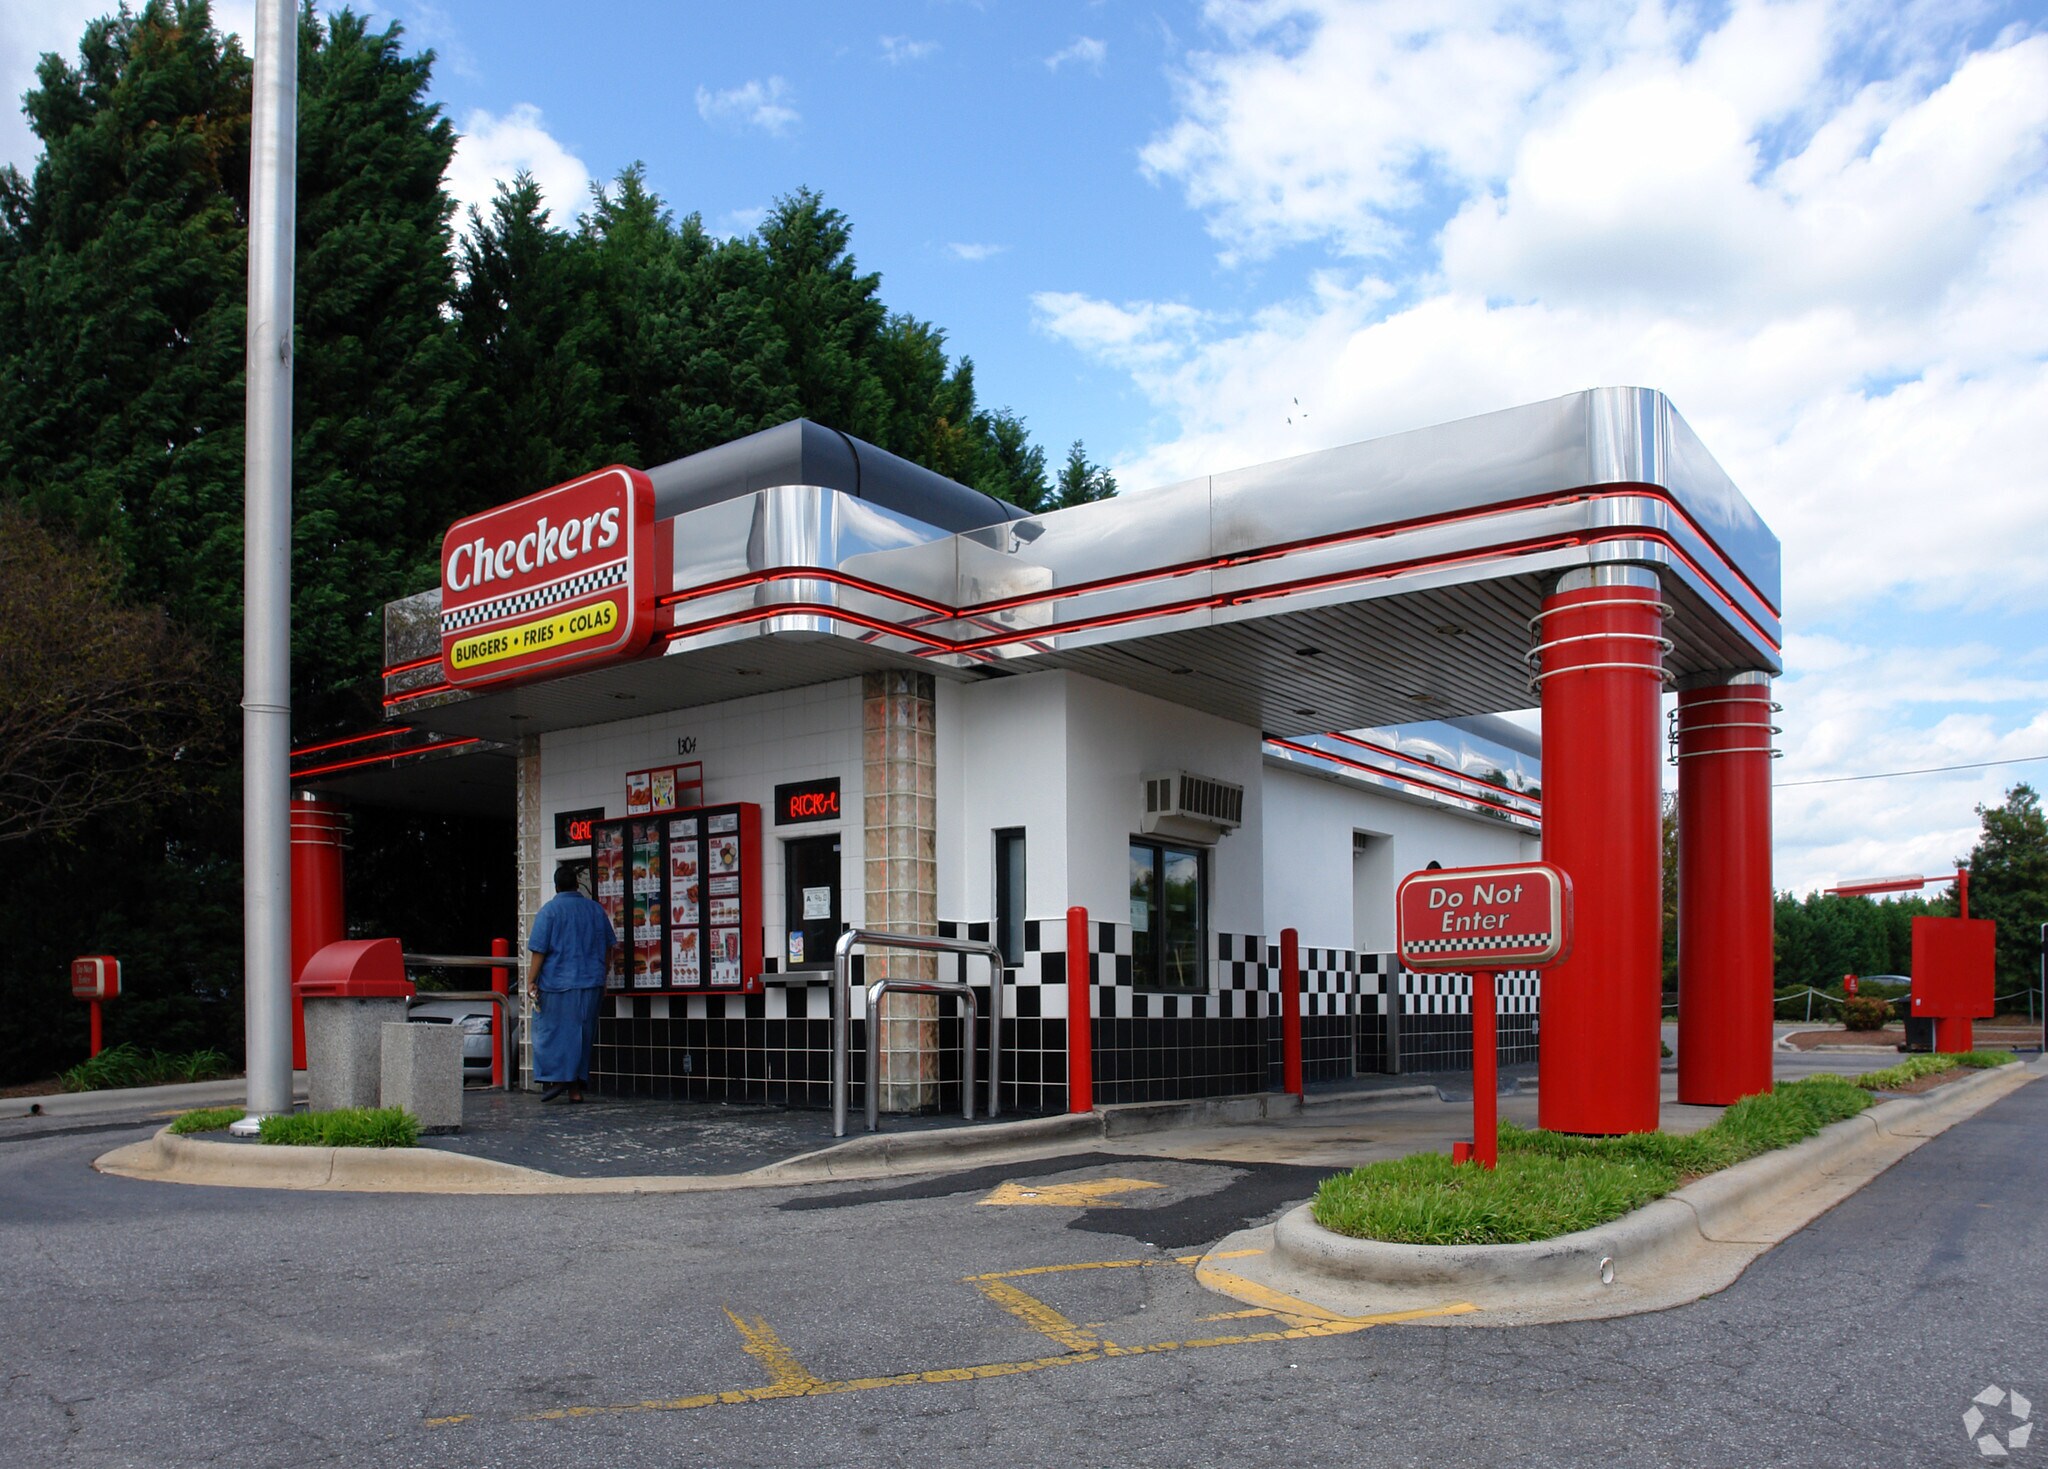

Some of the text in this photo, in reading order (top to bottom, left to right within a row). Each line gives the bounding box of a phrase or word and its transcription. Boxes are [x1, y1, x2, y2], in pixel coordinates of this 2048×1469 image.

[446, 506, 620, 592] Checkers
[455, 607, 611, 663] BURGERS FRIES COLAS
[678, 736, 697, 755] 1304
[1428, 883, 1523, 909] Do Not
[1441, 911, 1510, 933] Enter
